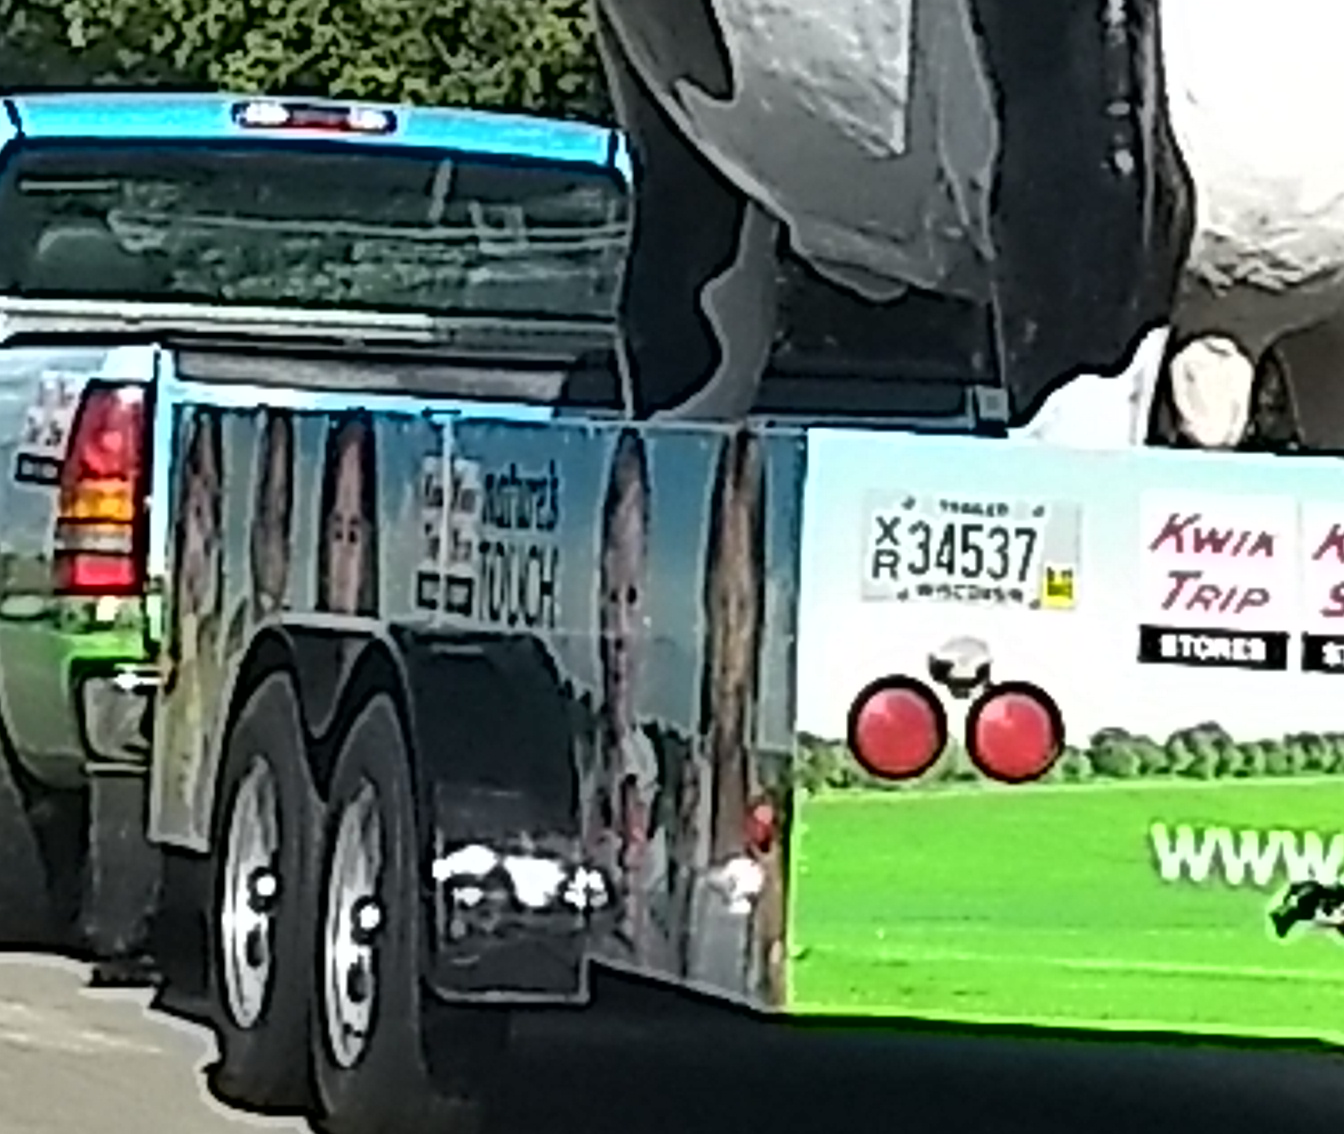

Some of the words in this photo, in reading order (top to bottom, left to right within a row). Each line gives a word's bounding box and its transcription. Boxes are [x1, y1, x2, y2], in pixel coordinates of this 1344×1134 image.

[906, 520, 1038, 583] 34537
[478, 541, 559, 629] TOUCH
[1161, 570, 1272, 614] TRIP
[1159, 634, 1267, 662] STORES
